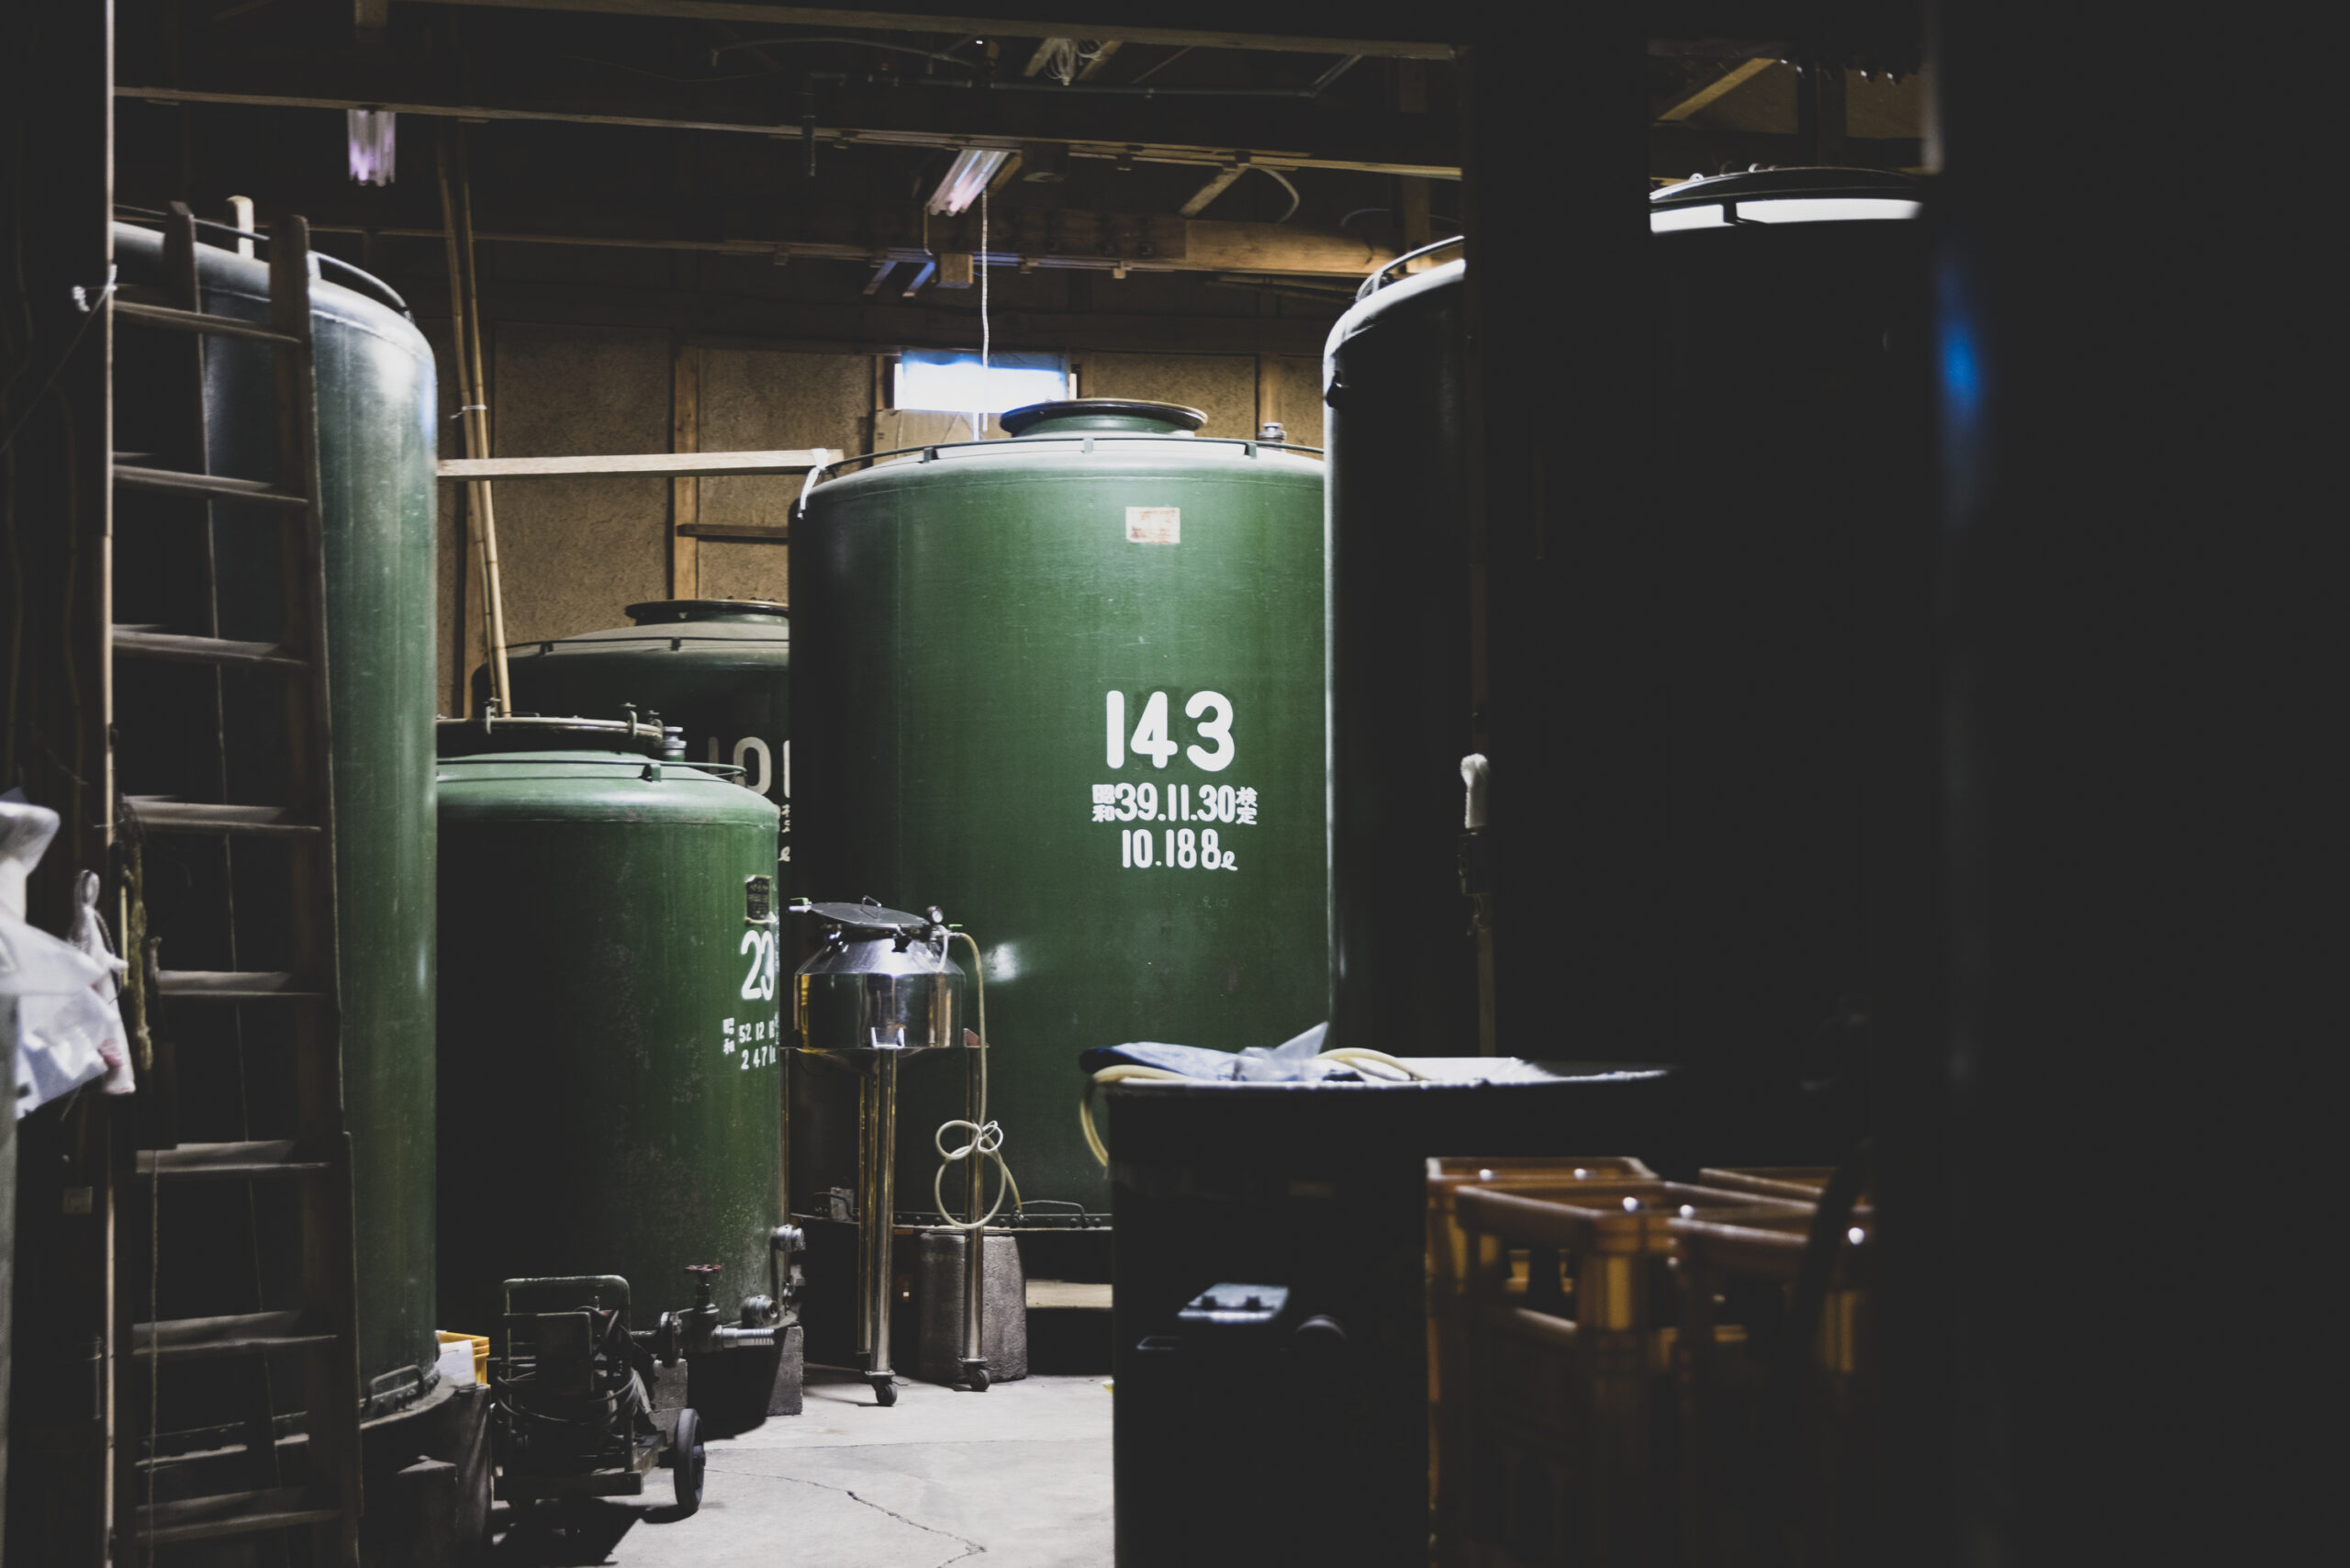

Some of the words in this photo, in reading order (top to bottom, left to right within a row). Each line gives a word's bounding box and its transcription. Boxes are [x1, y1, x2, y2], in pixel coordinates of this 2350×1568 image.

[1106, 689, 1236, 772] 143
[740, 929, 775, 1002] 23
[738, 1023, 752, 1043] 52
